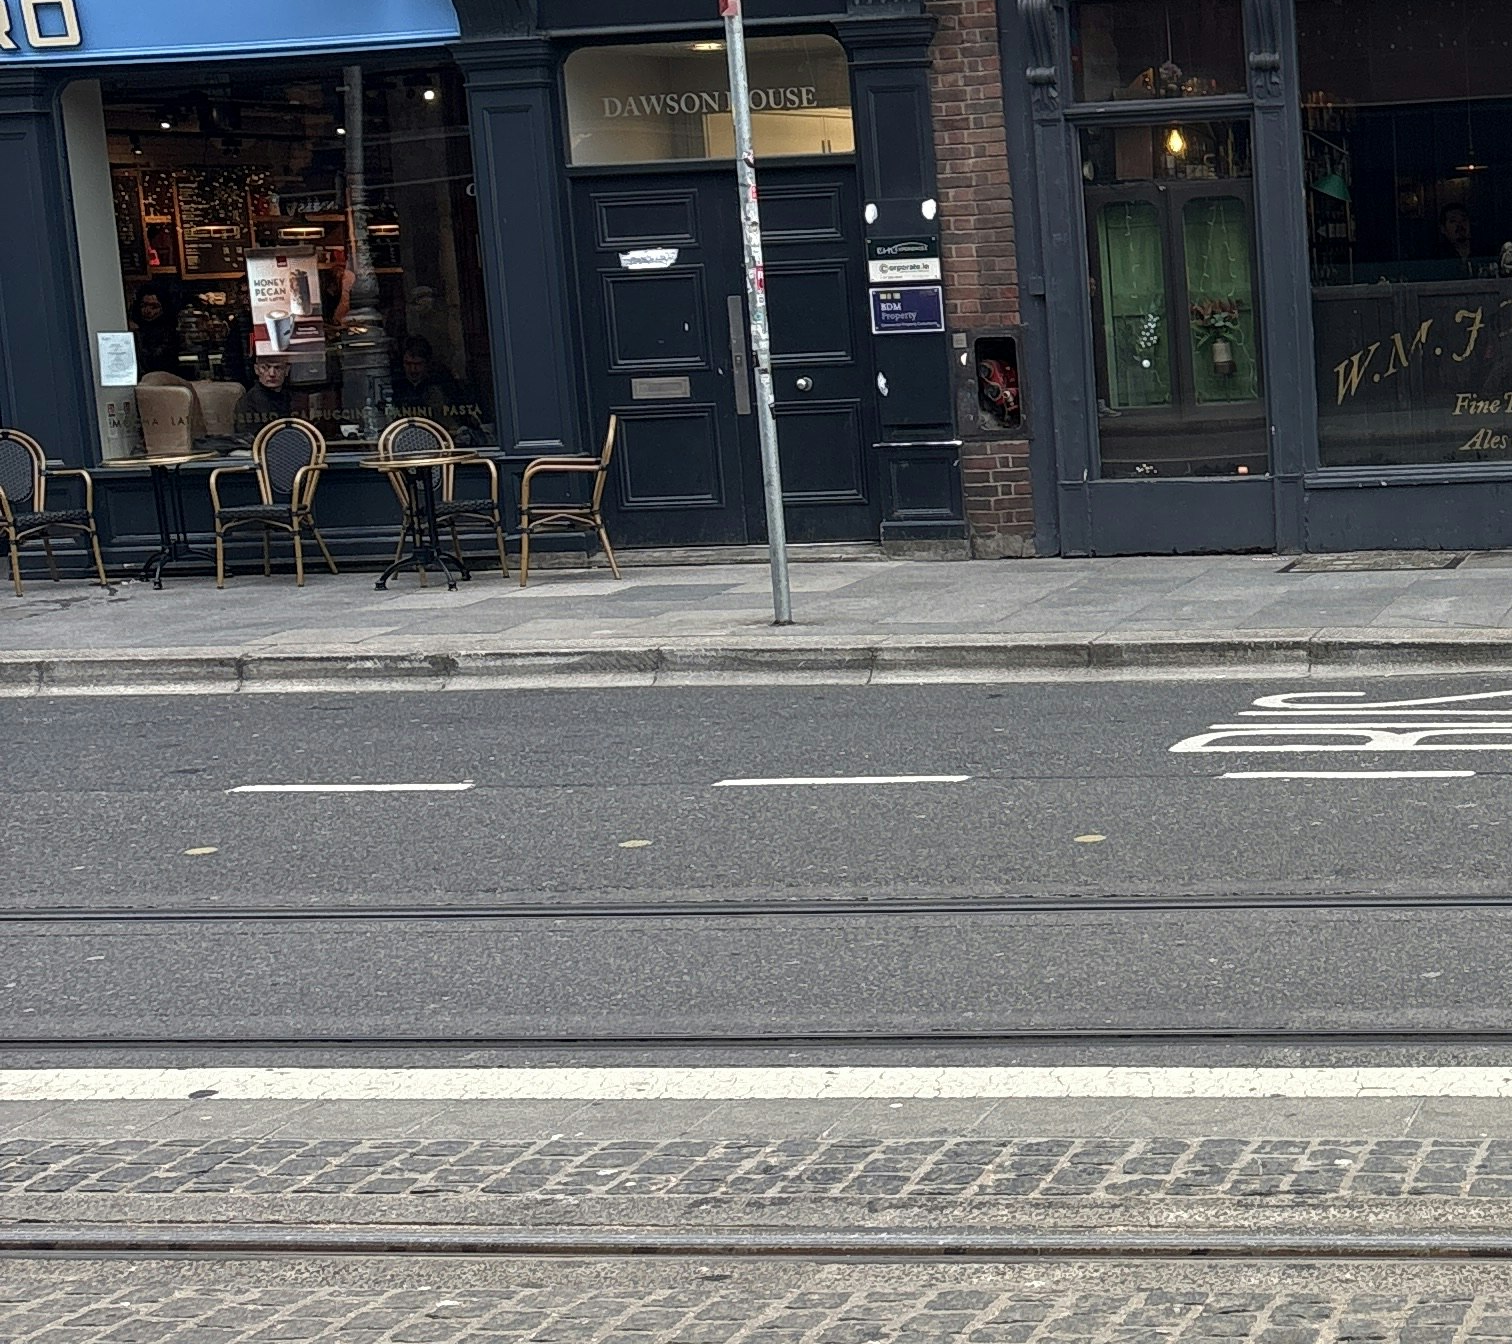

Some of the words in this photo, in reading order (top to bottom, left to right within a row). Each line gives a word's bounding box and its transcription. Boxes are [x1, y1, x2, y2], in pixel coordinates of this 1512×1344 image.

[601, 91, 720, 117] DAWSON
[253, 278, 286, 287] HONEY
[255, 287, 287, 297] PECAN
[881, 311, 917, 321] Property
[1452, 392, 1501, 416] Fine
[1459, 427, 1508, 451] Ales
